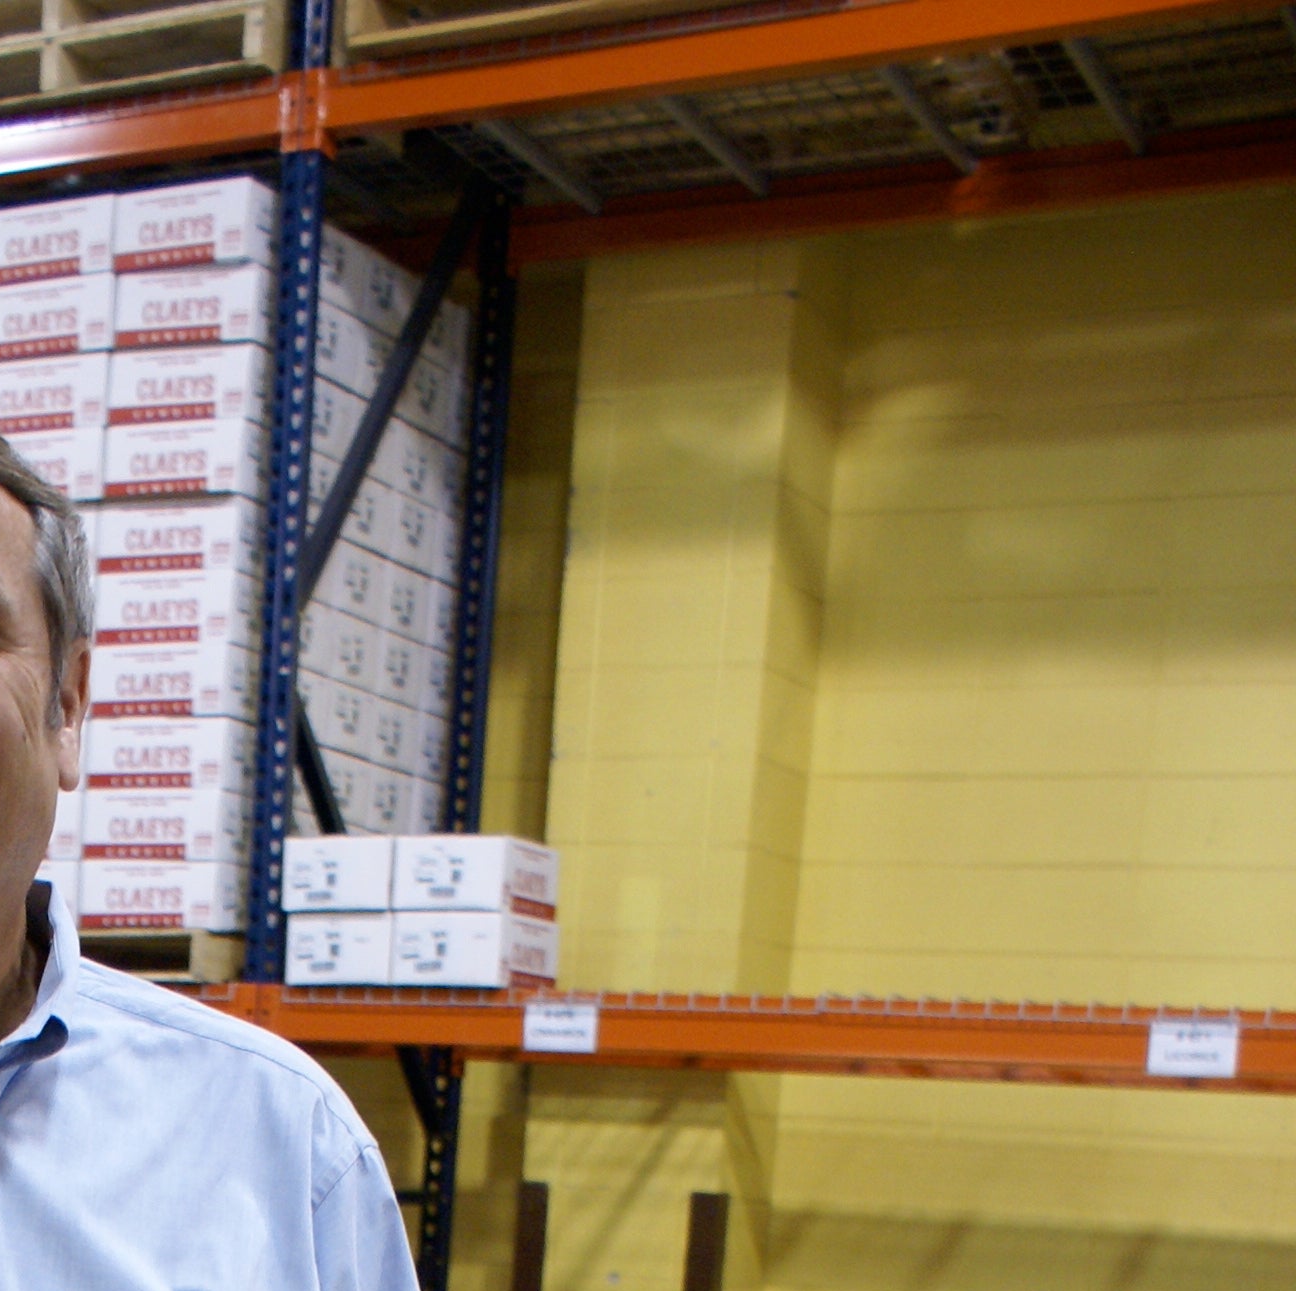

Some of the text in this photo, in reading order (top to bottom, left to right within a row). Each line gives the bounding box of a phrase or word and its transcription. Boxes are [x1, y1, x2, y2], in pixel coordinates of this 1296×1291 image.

[138, 213, 215, 245] CLAEYS
[142, 296, 221, 324] CLAEYS
[136, 374, 215, 400] CLAEYS
[129, 450, 206, 476] CLAEYS
[124, 525, 202, 552] CLAEYS
[122, 599, 198, 624] CLAEYS
[116, 672, 191, 696] CLAEYS
[114, 746, 190, 769] CLAEYS
[109, 817, 184, 840] CLAEYS
[106, 887, 182, 909] CLAEYS
